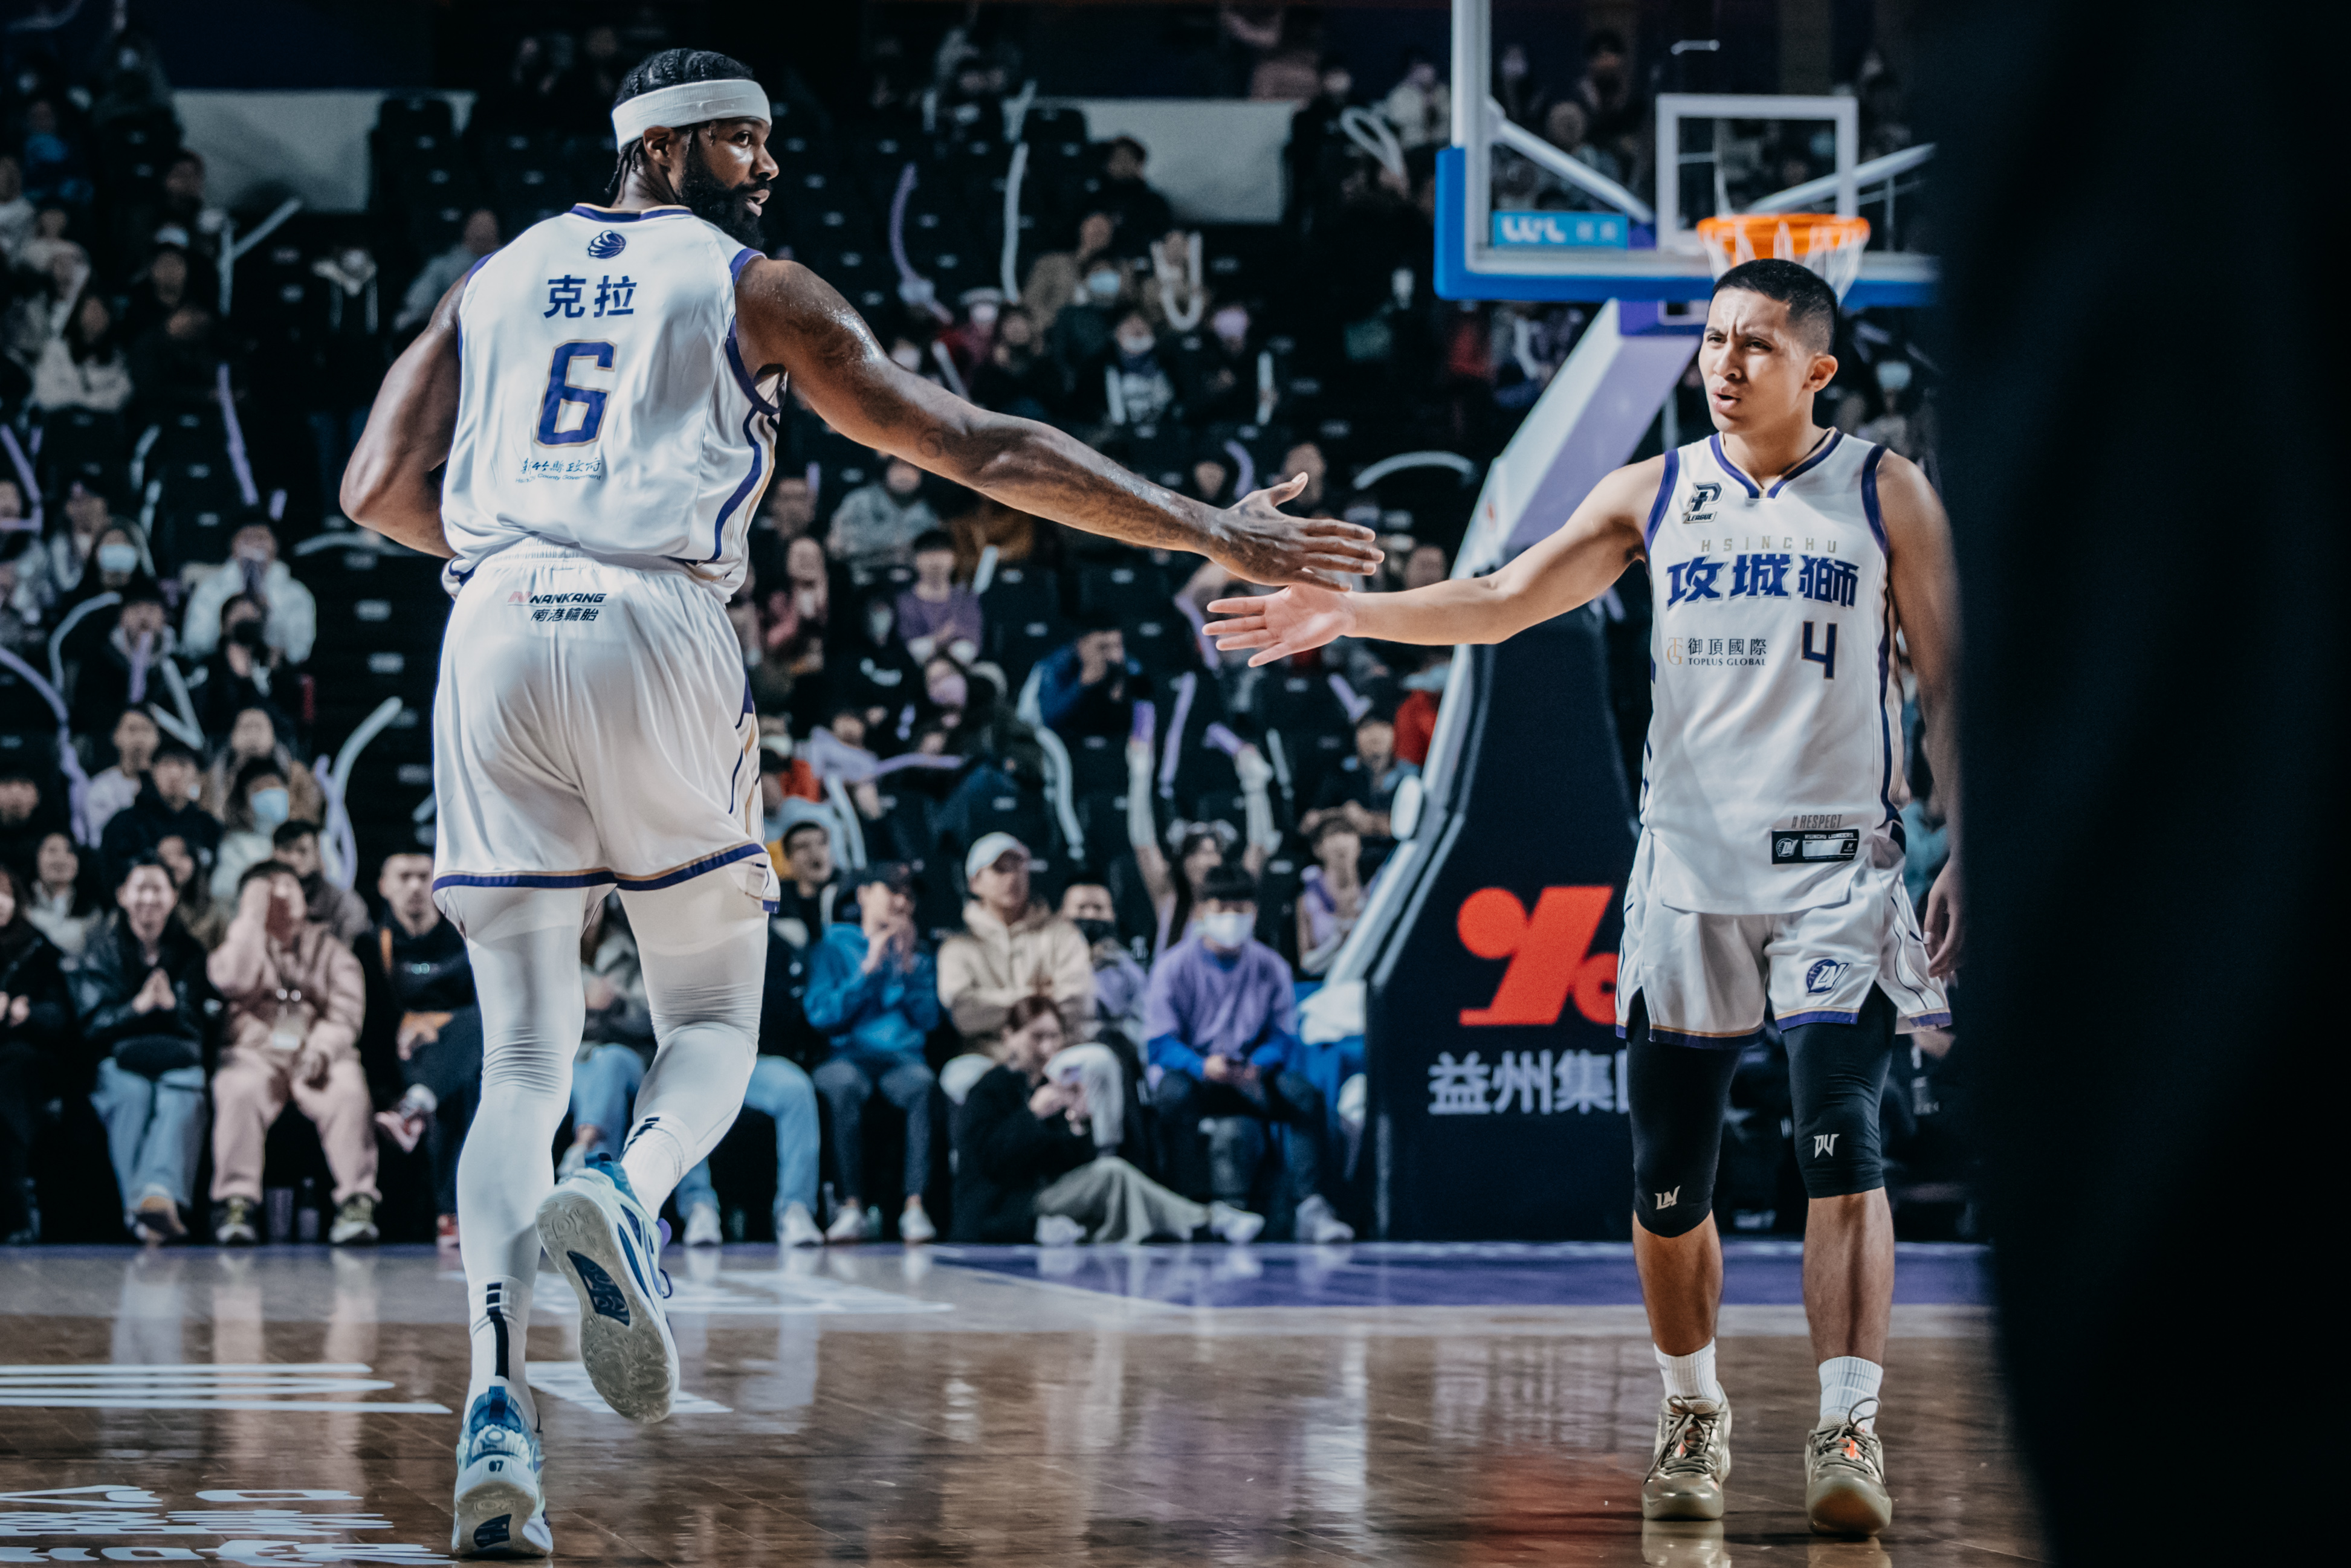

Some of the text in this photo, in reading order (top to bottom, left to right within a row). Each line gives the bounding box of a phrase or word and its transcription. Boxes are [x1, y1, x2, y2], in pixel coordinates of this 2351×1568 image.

[543, 274, 638, 319] 克拉
[534, 338, 618, 448] 6
[1701, 535, 1837, 553] HSINCHU
[1666, 553, 1860, 611] 攻城獅
[529, 593, 607, 604] NANKANG
[531, 607, 599, 622] 南港輪胎
[1688, 638, 1767, 656] 御頂國際
[1801, 621, 1838, 680] 4
[1800, 815, 1842, 828] RESPECT
[488, 1460, 504, 1472] 07
